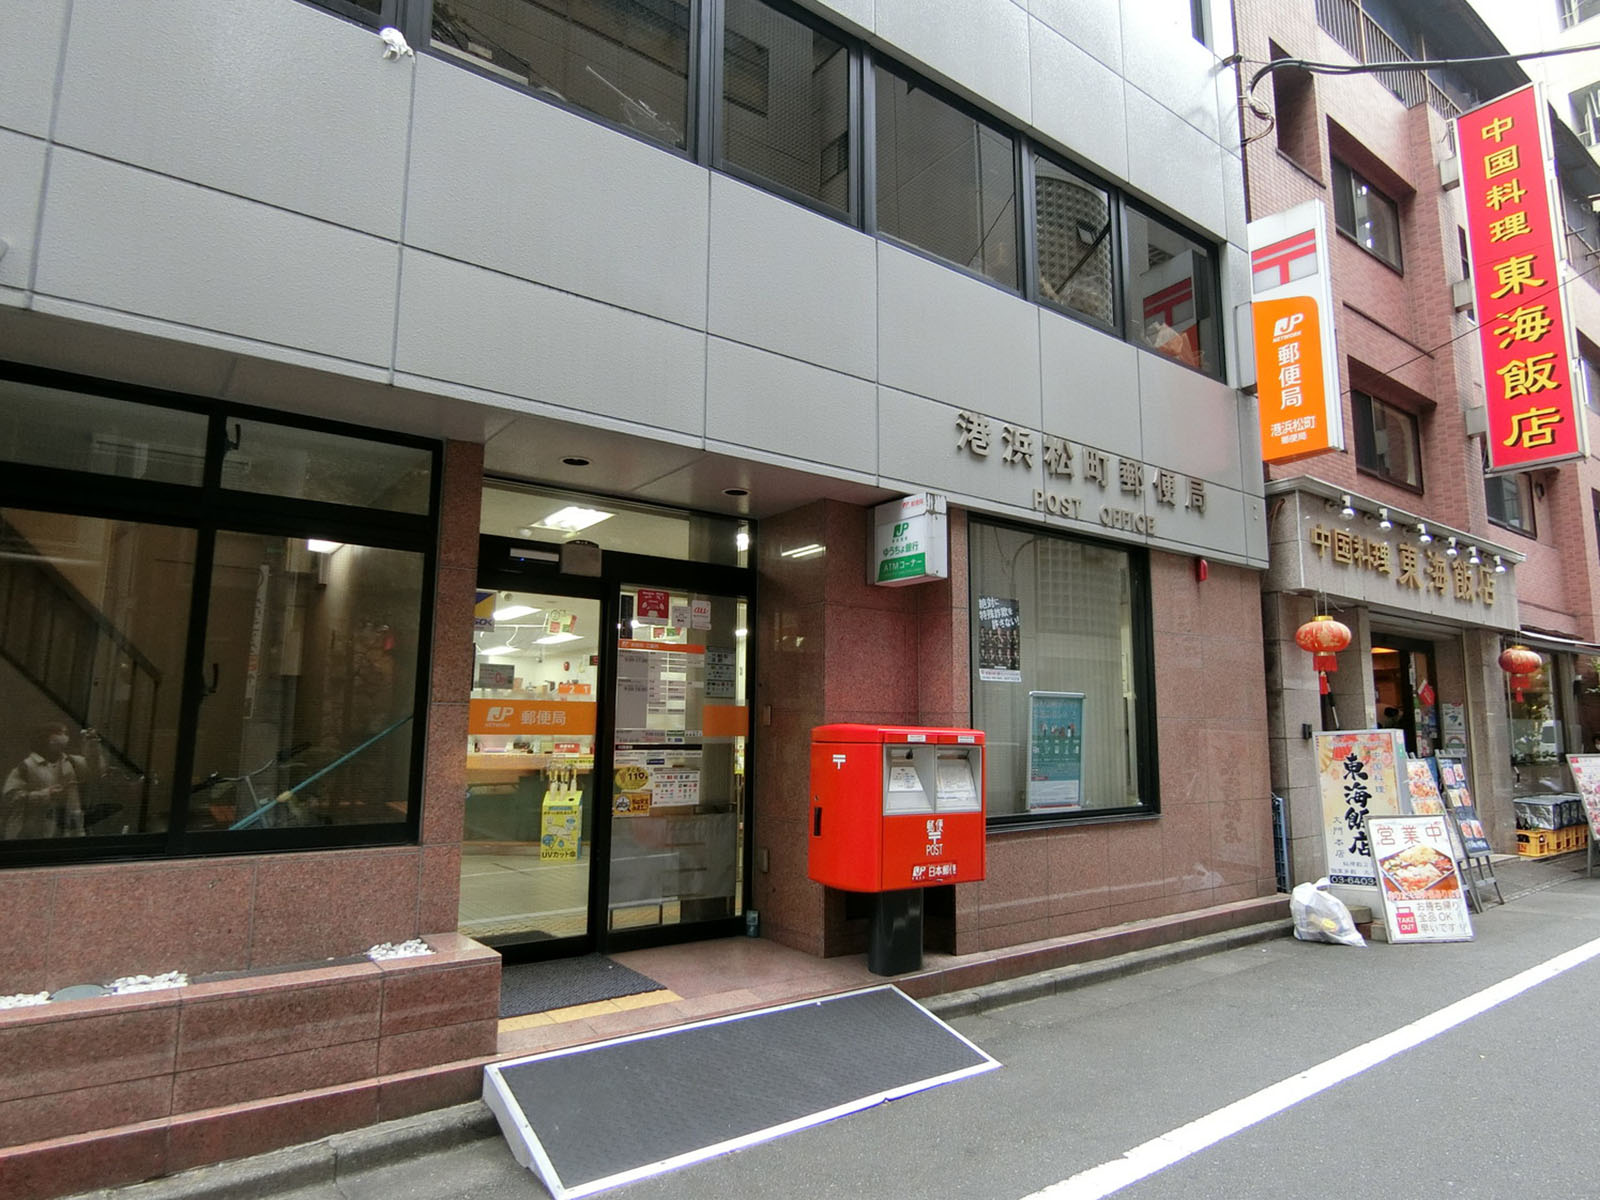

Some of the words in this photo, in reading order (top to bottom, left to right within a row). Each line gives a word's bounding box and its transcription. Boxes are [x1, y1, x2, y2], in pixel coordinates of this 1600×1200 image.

[1481, 116, 1532, 244] 中国料理
[1490, 254, 1563, 449] 東海飯店
[1278, 342, 1303, 411] 郵便局
[1270, 416, 1317, 437] 港浜松町
[1280, 432, 1307, 445] 郵便局
[955, 409, 1208, 514] 港浜松町郵便局
[1032, 488, 1083, 519] POST
[1098, 504, 1158, 536] OFFICE
[1310, 524, 1393, 575] 中国料理
[1397, 543, 1496, 606] 東海飯店
[693, 606, 709, 614] au
[520, 710, 567, 726] 郵便局
[1343, 752, 1372, 858] 東海飯店
[926, 844, 944, 857] POST
[1376, 823, 1443, 846] 営業中
